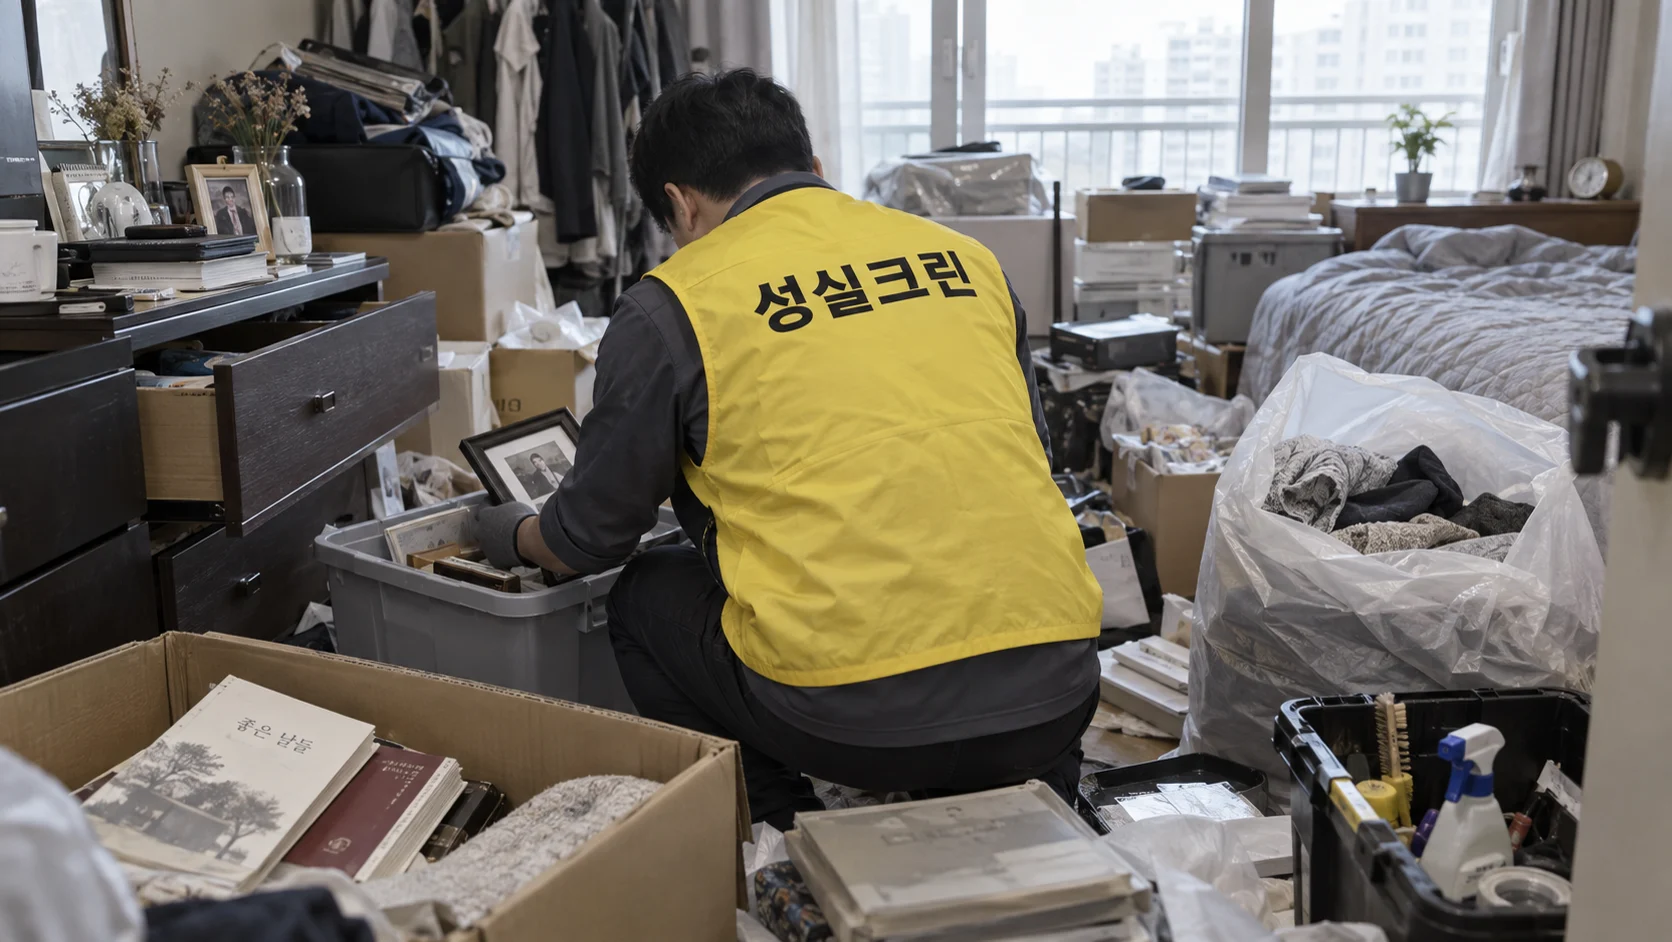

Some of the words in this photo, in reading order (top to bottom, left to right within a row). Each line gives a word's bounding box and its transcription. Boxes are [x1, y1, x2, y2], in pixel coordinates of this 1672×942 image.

[755, 250, 978, 334] 성실크린
[237, 717, 272, 740] 좋은
[276, 732, 314, 755] 날들
